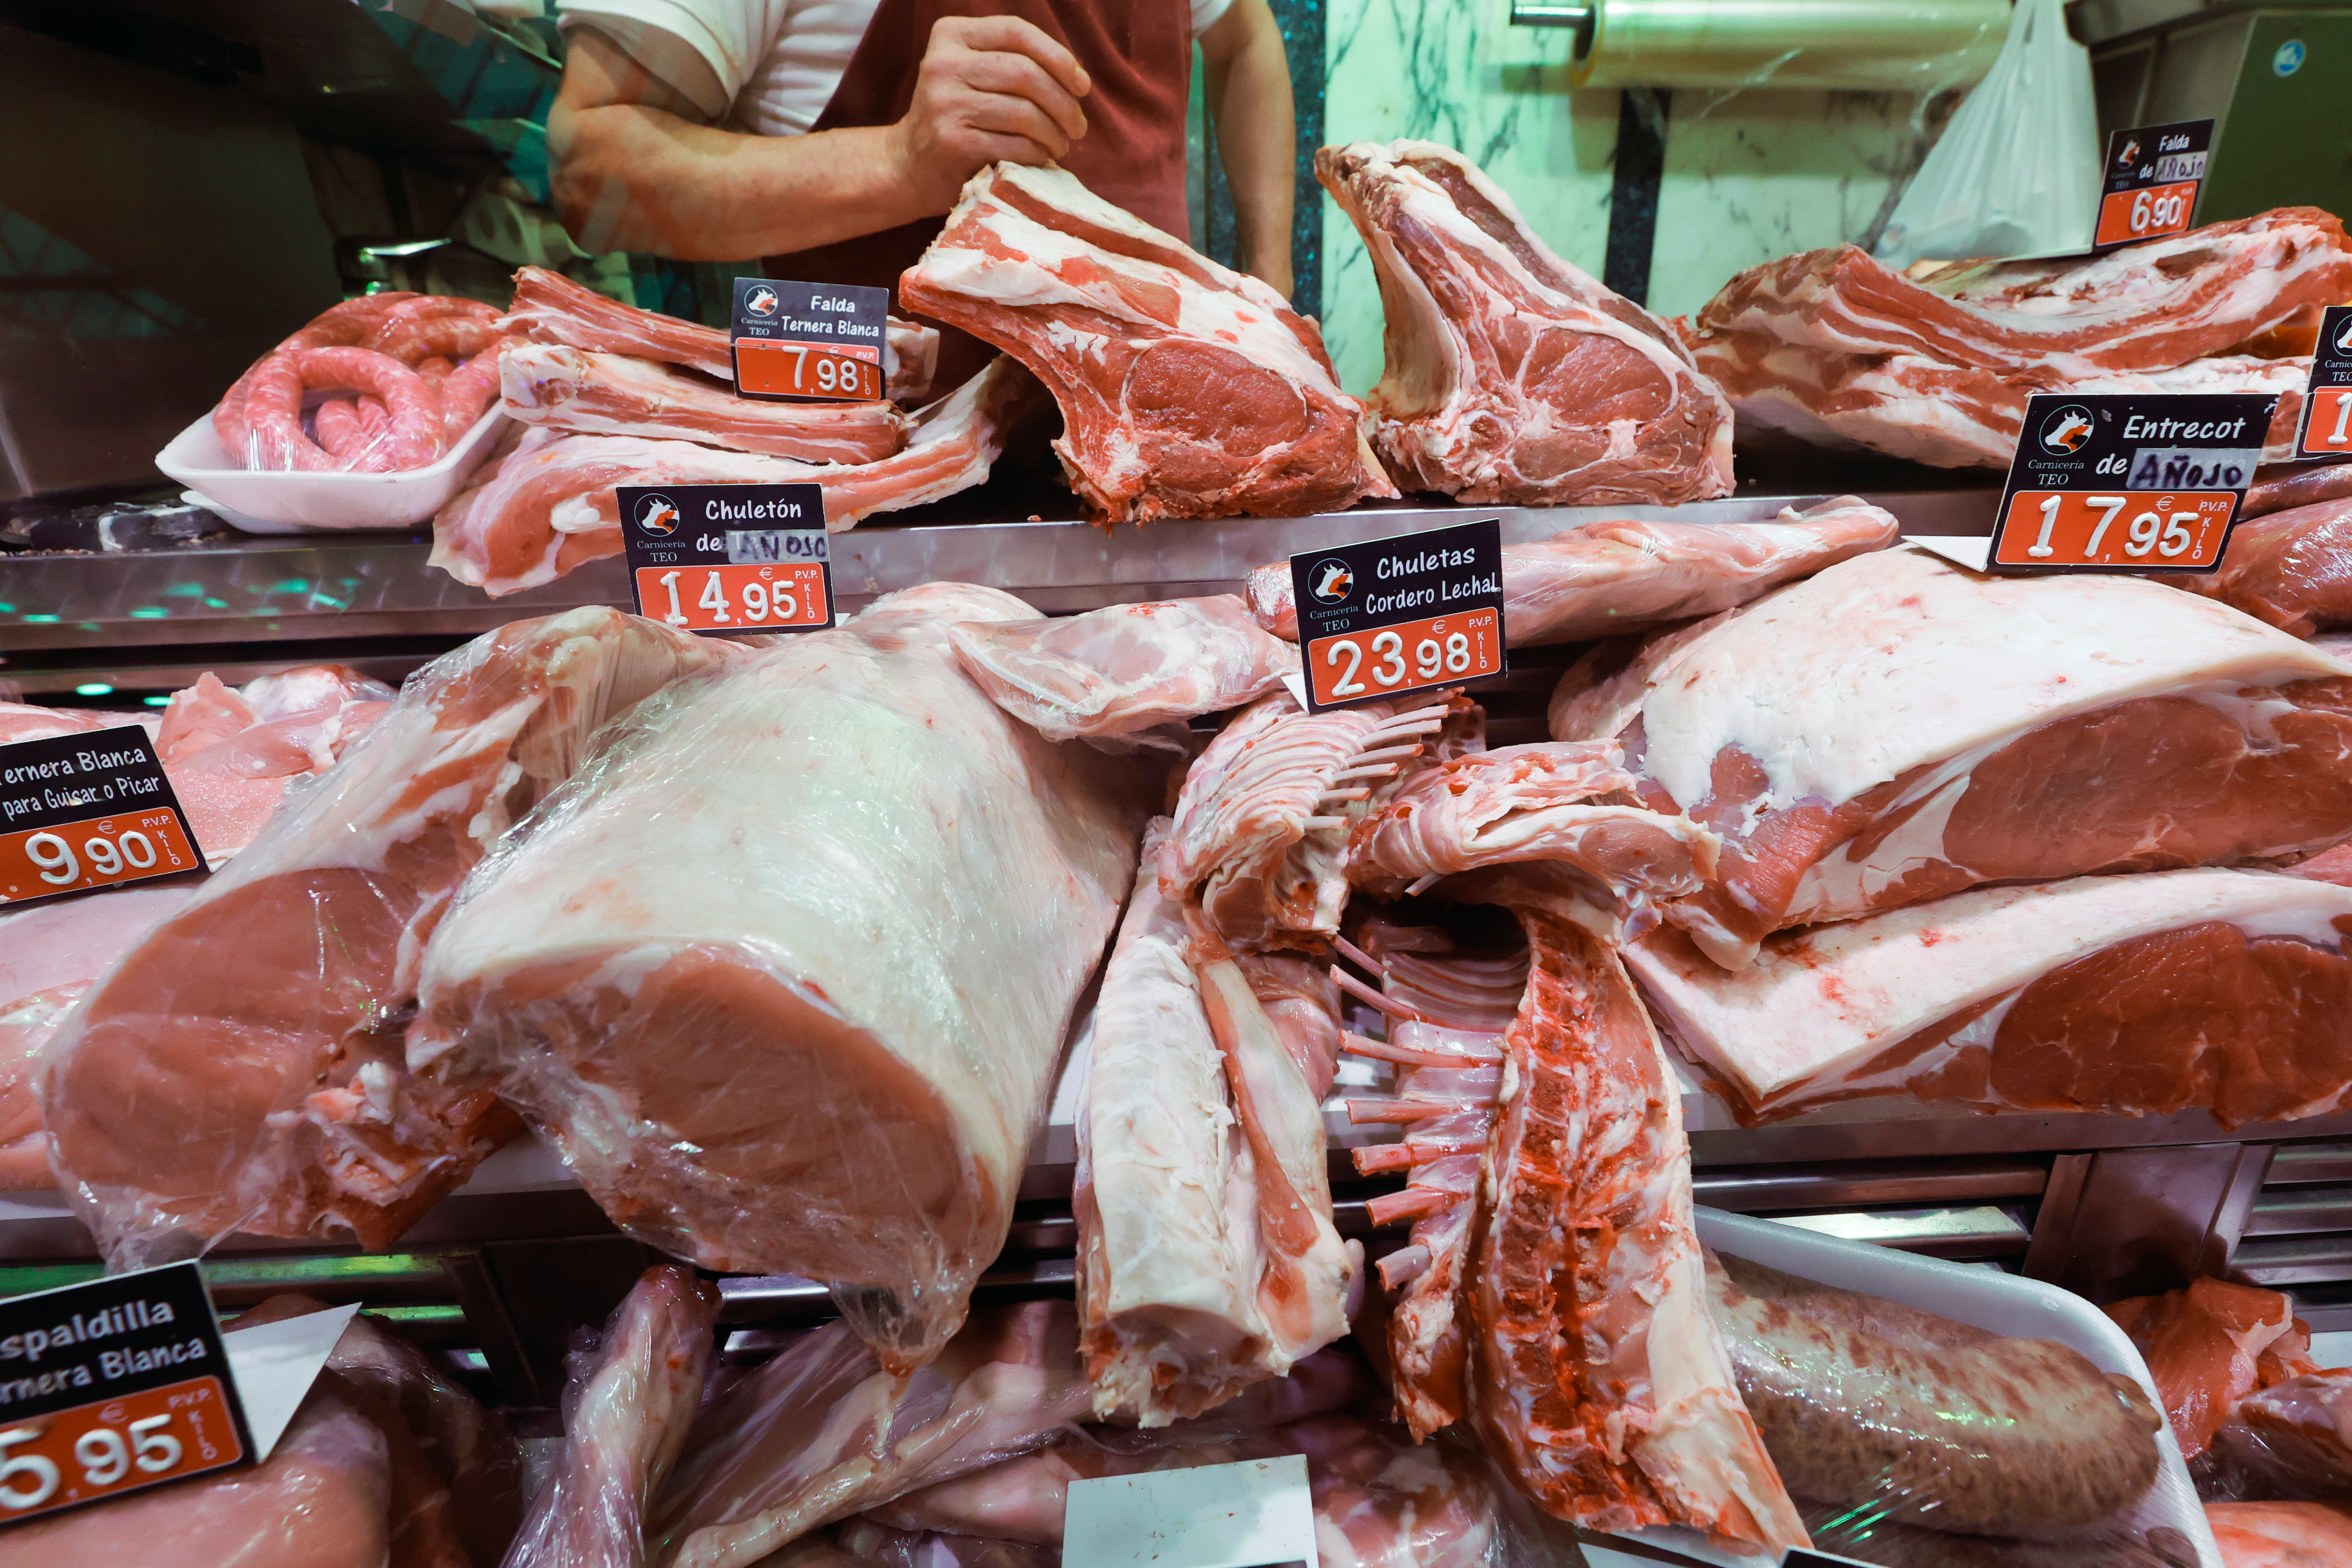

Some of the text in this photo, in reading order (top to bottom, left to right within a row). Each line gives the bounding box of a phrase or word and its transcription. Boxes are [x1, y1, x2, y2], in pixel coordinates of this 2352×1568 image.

[2159, 134, 2190, 152] Falda
[2139, 164, 2153, 179] de
[811, 295, 855, 312] Falda
[741, 317, 778, 326] Carnicería
[781, 316, 879, 337] Ternera Blanca
[856, 351, 874, 359] P.V.P.
[2122, 415, 2246, 439] Entrecot
[2028, 459, 2084, 470] Carnicería
[2095, 454, 2128, 475] de
[2037, 474, 2068, 485] TEO
[705, 498, 802, 520] Chuletón
[2198, 501, 2228, 512] P.V.P.
[2027, 495, 2200, 563] 17,95
[2192, 517, 2212, 559] KILO
[637, 540, 685, 549] Carnicería
[696, 533, 722, 551] de
[650, 552, 677, 562] TEO
[1377, 548, 1475, 579] Chuletas
[795, 570, 818, 579] P.V.P.
[660, 571, 797, 626] 14,95
[804, 583, 815, 620] KILO
[1366, 572, 1499, 614] Cordero Lechal
[1310, 604, 1359, 620] Carnicería
[1469, 616, 1492, 628] P.V.P.
[1323, 618, 1350, 632] TEO
[1478, 631, 1487, 669] KILO
[1327, 631, 1470, 696] 23,98
[0, 748, 147, 785] ernera Blanca
[2, 776, 159, 822] para Guisar o Picar
[142, 815, 172, 828] P.V.P.
[25, 831, 157, 885] 9,90
[157, 830, 181, 866] KILO
[98, 1337, 208, 1380] Blanca
